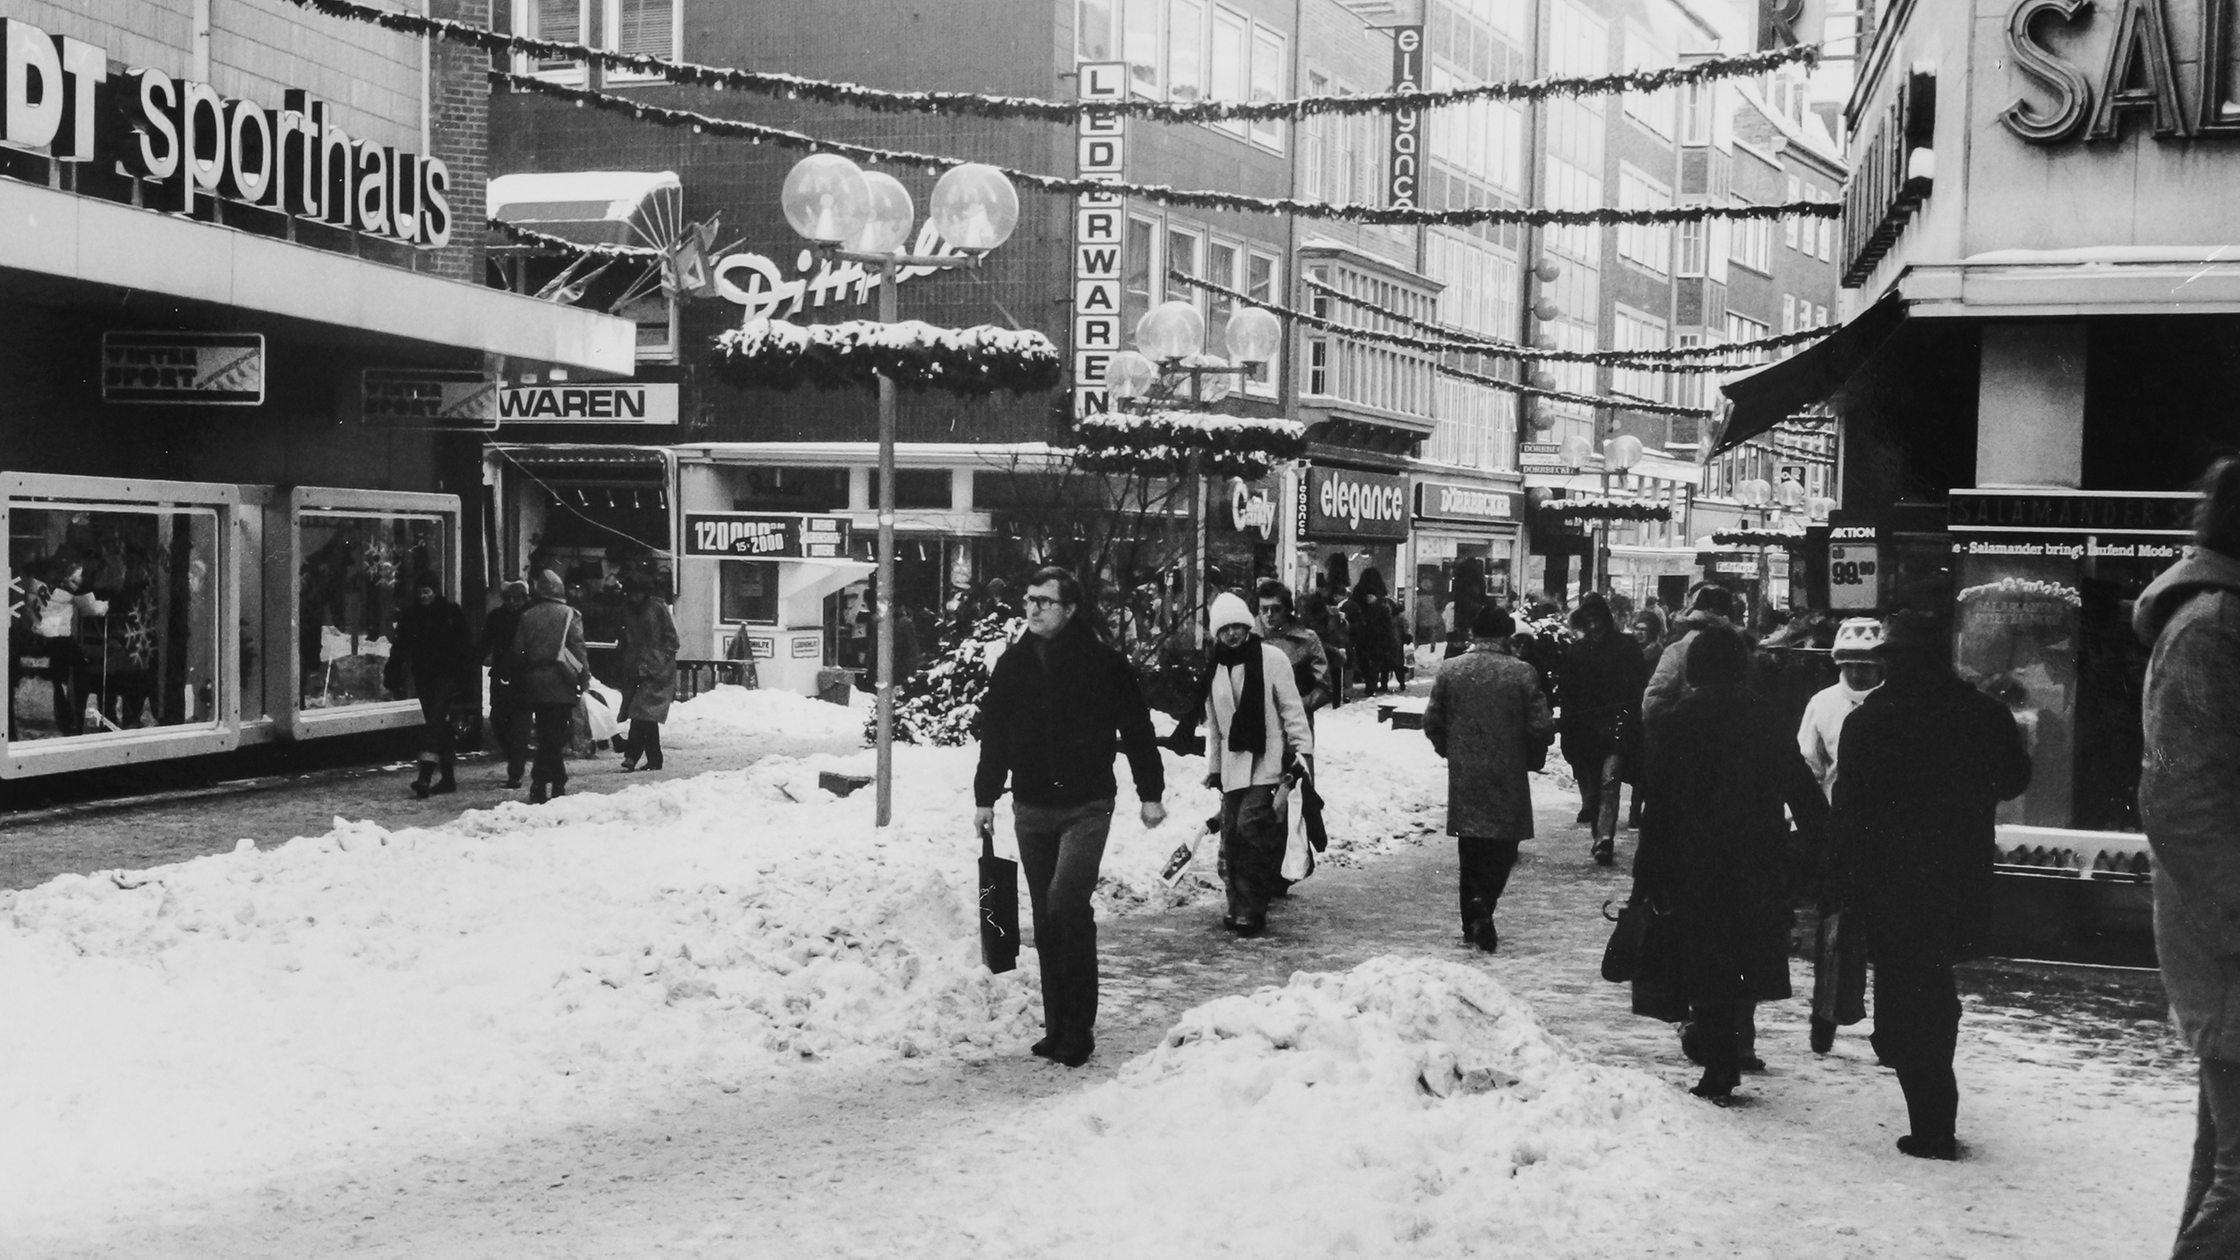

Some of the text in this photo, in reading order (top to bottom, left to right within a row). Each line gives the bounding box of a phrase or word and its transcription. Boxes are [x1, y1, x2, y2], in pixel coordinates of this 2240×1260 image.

[1999, 0, 2240, 142] SAL
[3, 17, 452, 249] DT sporthaus
[500, 388, 646, 419] WAREN
[1319, 472, 1404, 531] elegance
[750, 533, 785, 554] 2000
[1829, 527, 1876, 539] AKTION
[1969, 541, 2044, 555] Salamander
[2045, 542, 2085, 559] bringt
[2138, 544, 2174, 557] Mode
